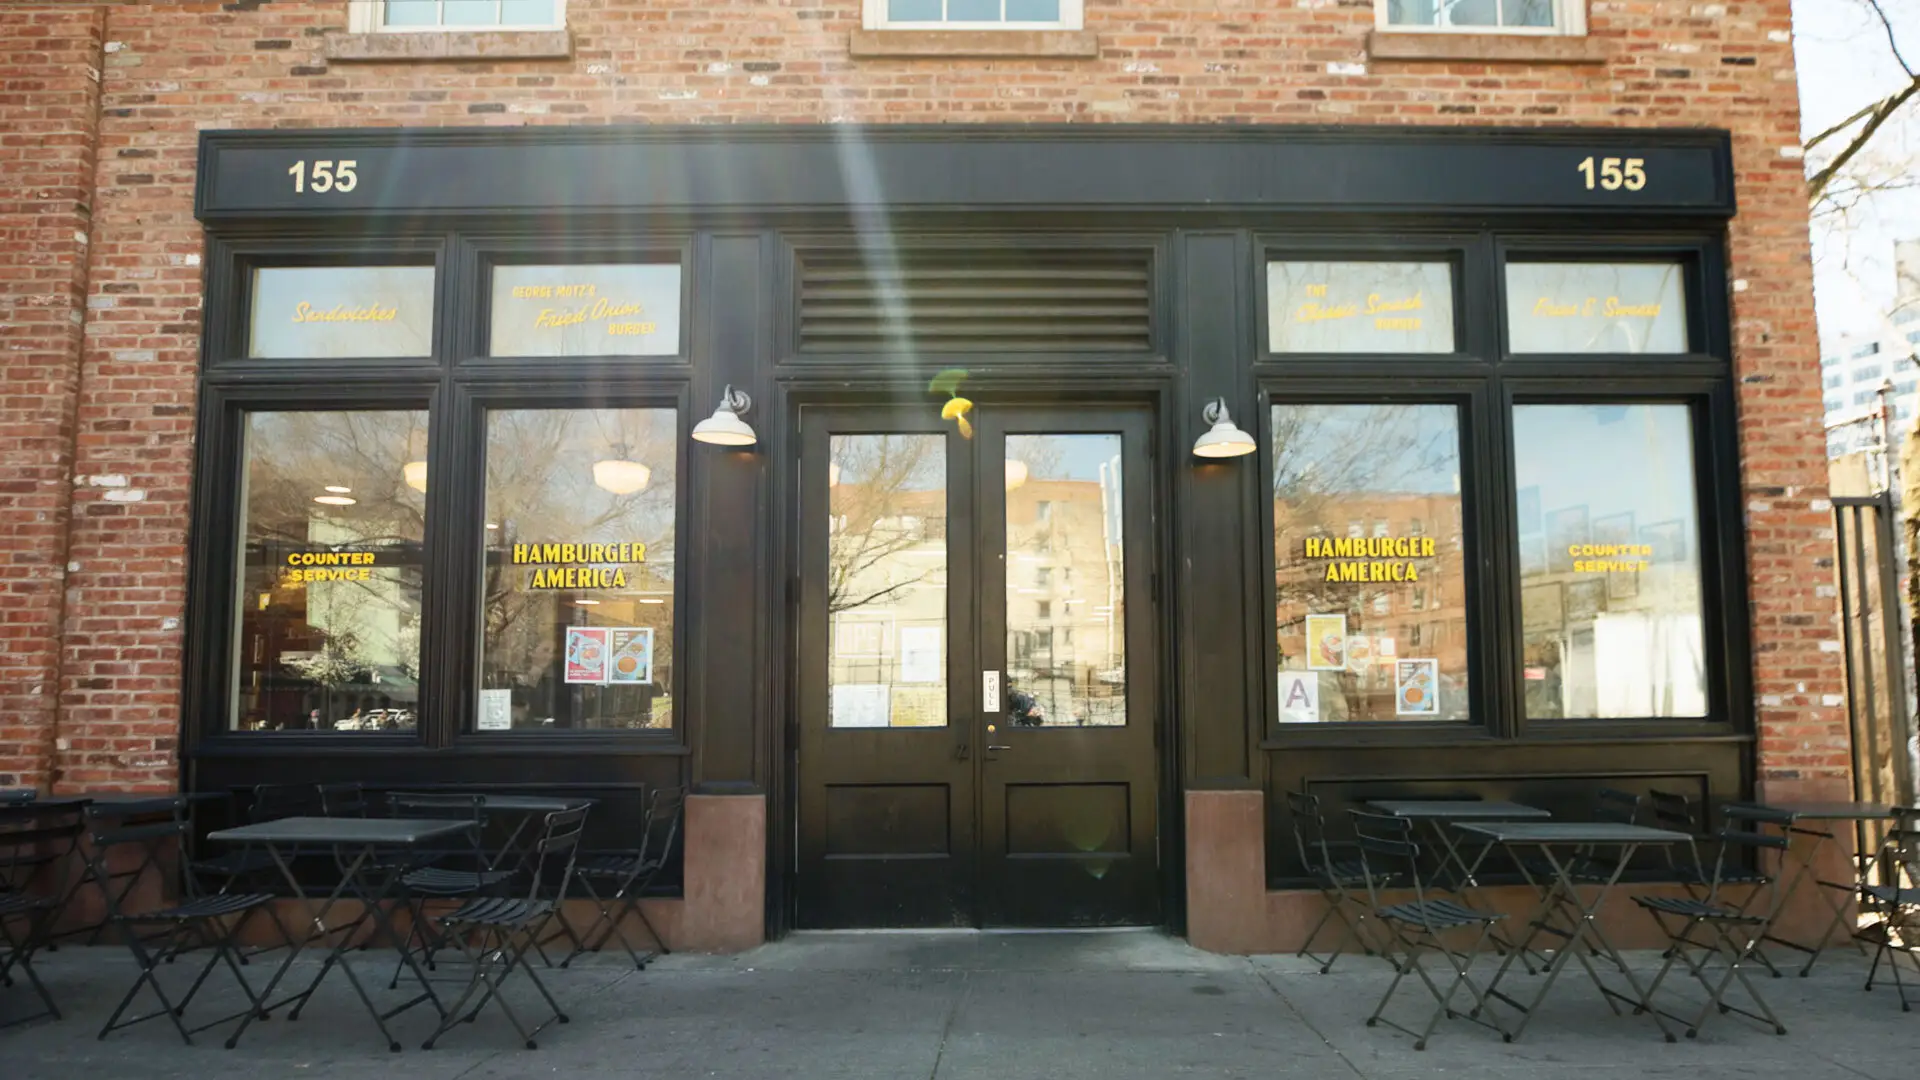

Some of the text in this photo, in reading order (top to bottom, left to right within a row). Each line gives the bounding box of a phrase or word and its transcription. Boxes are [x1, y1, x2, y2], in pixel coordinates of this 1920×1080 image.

[288, 159, 358, 193] 155
[1577, 156, 1647, 191] 155
[512, 286, 552, 298] GEORGE
[293, 300, 397, 323] Sandwiches
[535, 297, 642, 329] Fried Onion
[608, 323, 656, 335] BURGER
[513, 542, 646, 564] HAMBURGER
[1305, 536, 1436, 558] HAMBURGER
[1568, 543, 1653, 557] COUNTER
[287, 551, 376, 566] COUNTER
[1572, 559, 1650, 573] SERVICE
[290, 568, 371, 582] SERVICE
[531, 567, 628, 589] AMERICA
[1324, 560, 1420, 582] AMERICA
[1285, 678, 1311, 708] A
